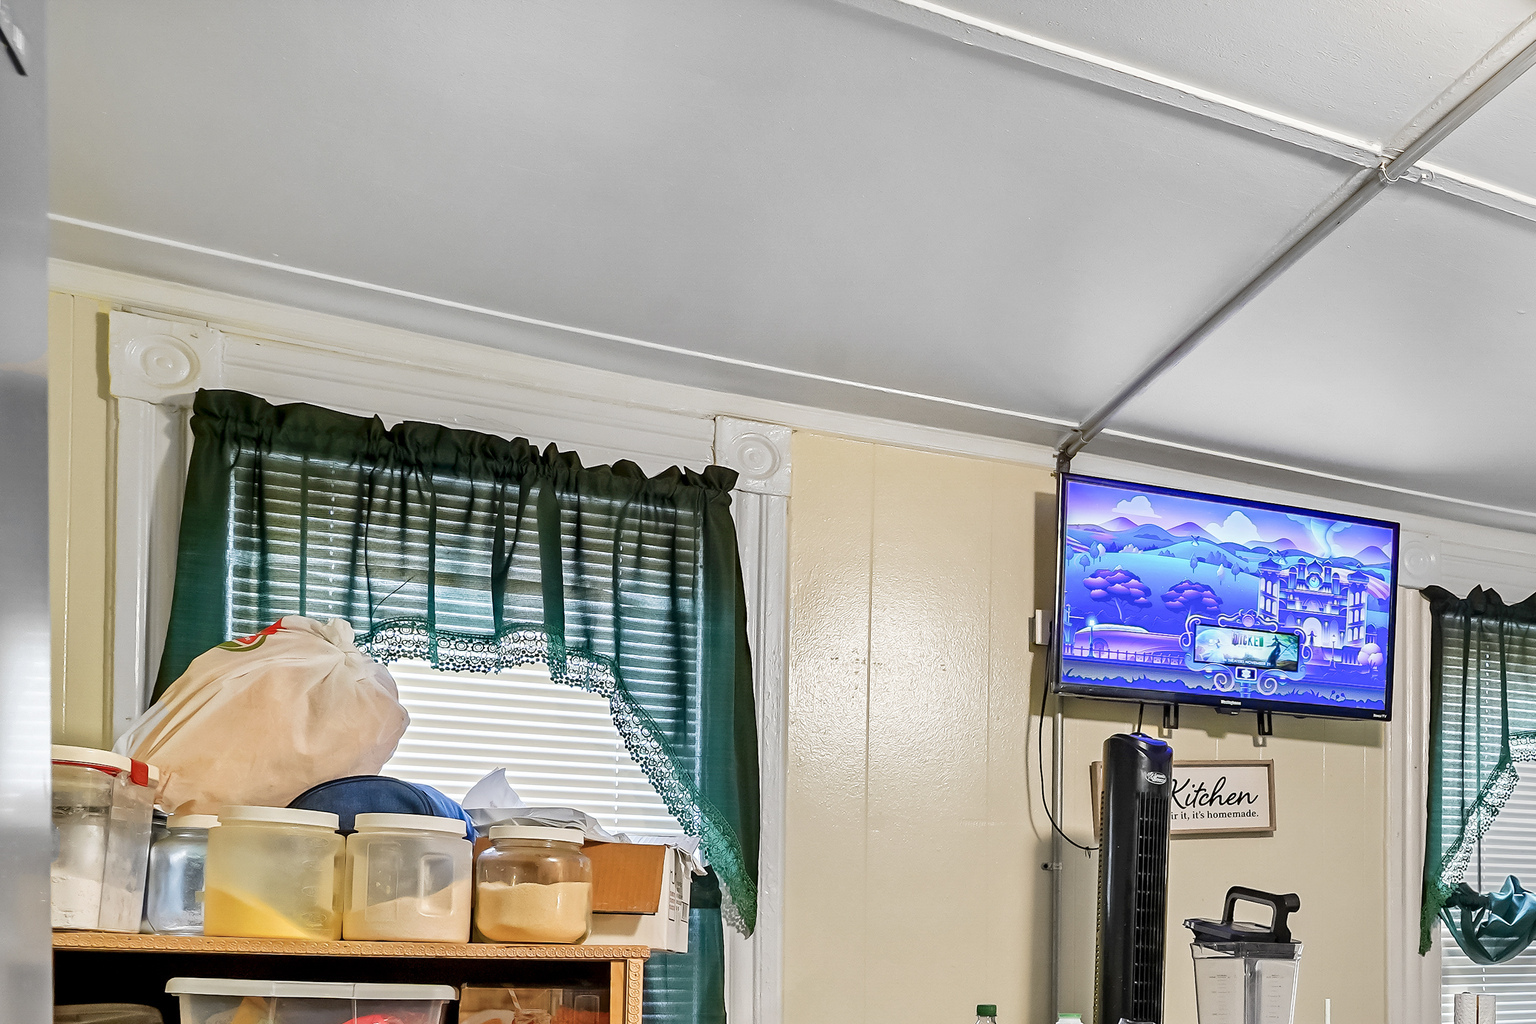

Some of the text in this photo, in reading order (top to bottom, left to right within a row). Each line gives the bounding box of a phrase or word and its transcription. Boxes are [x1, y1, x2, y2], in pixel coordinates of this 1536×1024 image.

[1232, 633, 1264, 647] WICKED
[1172, 776, 1258, 810] Kitchen
[1181, 812, 1190, 821] it,
[1192, 811, 1205, 819] it's
[1207, 809, 1259, 819] homemade.
